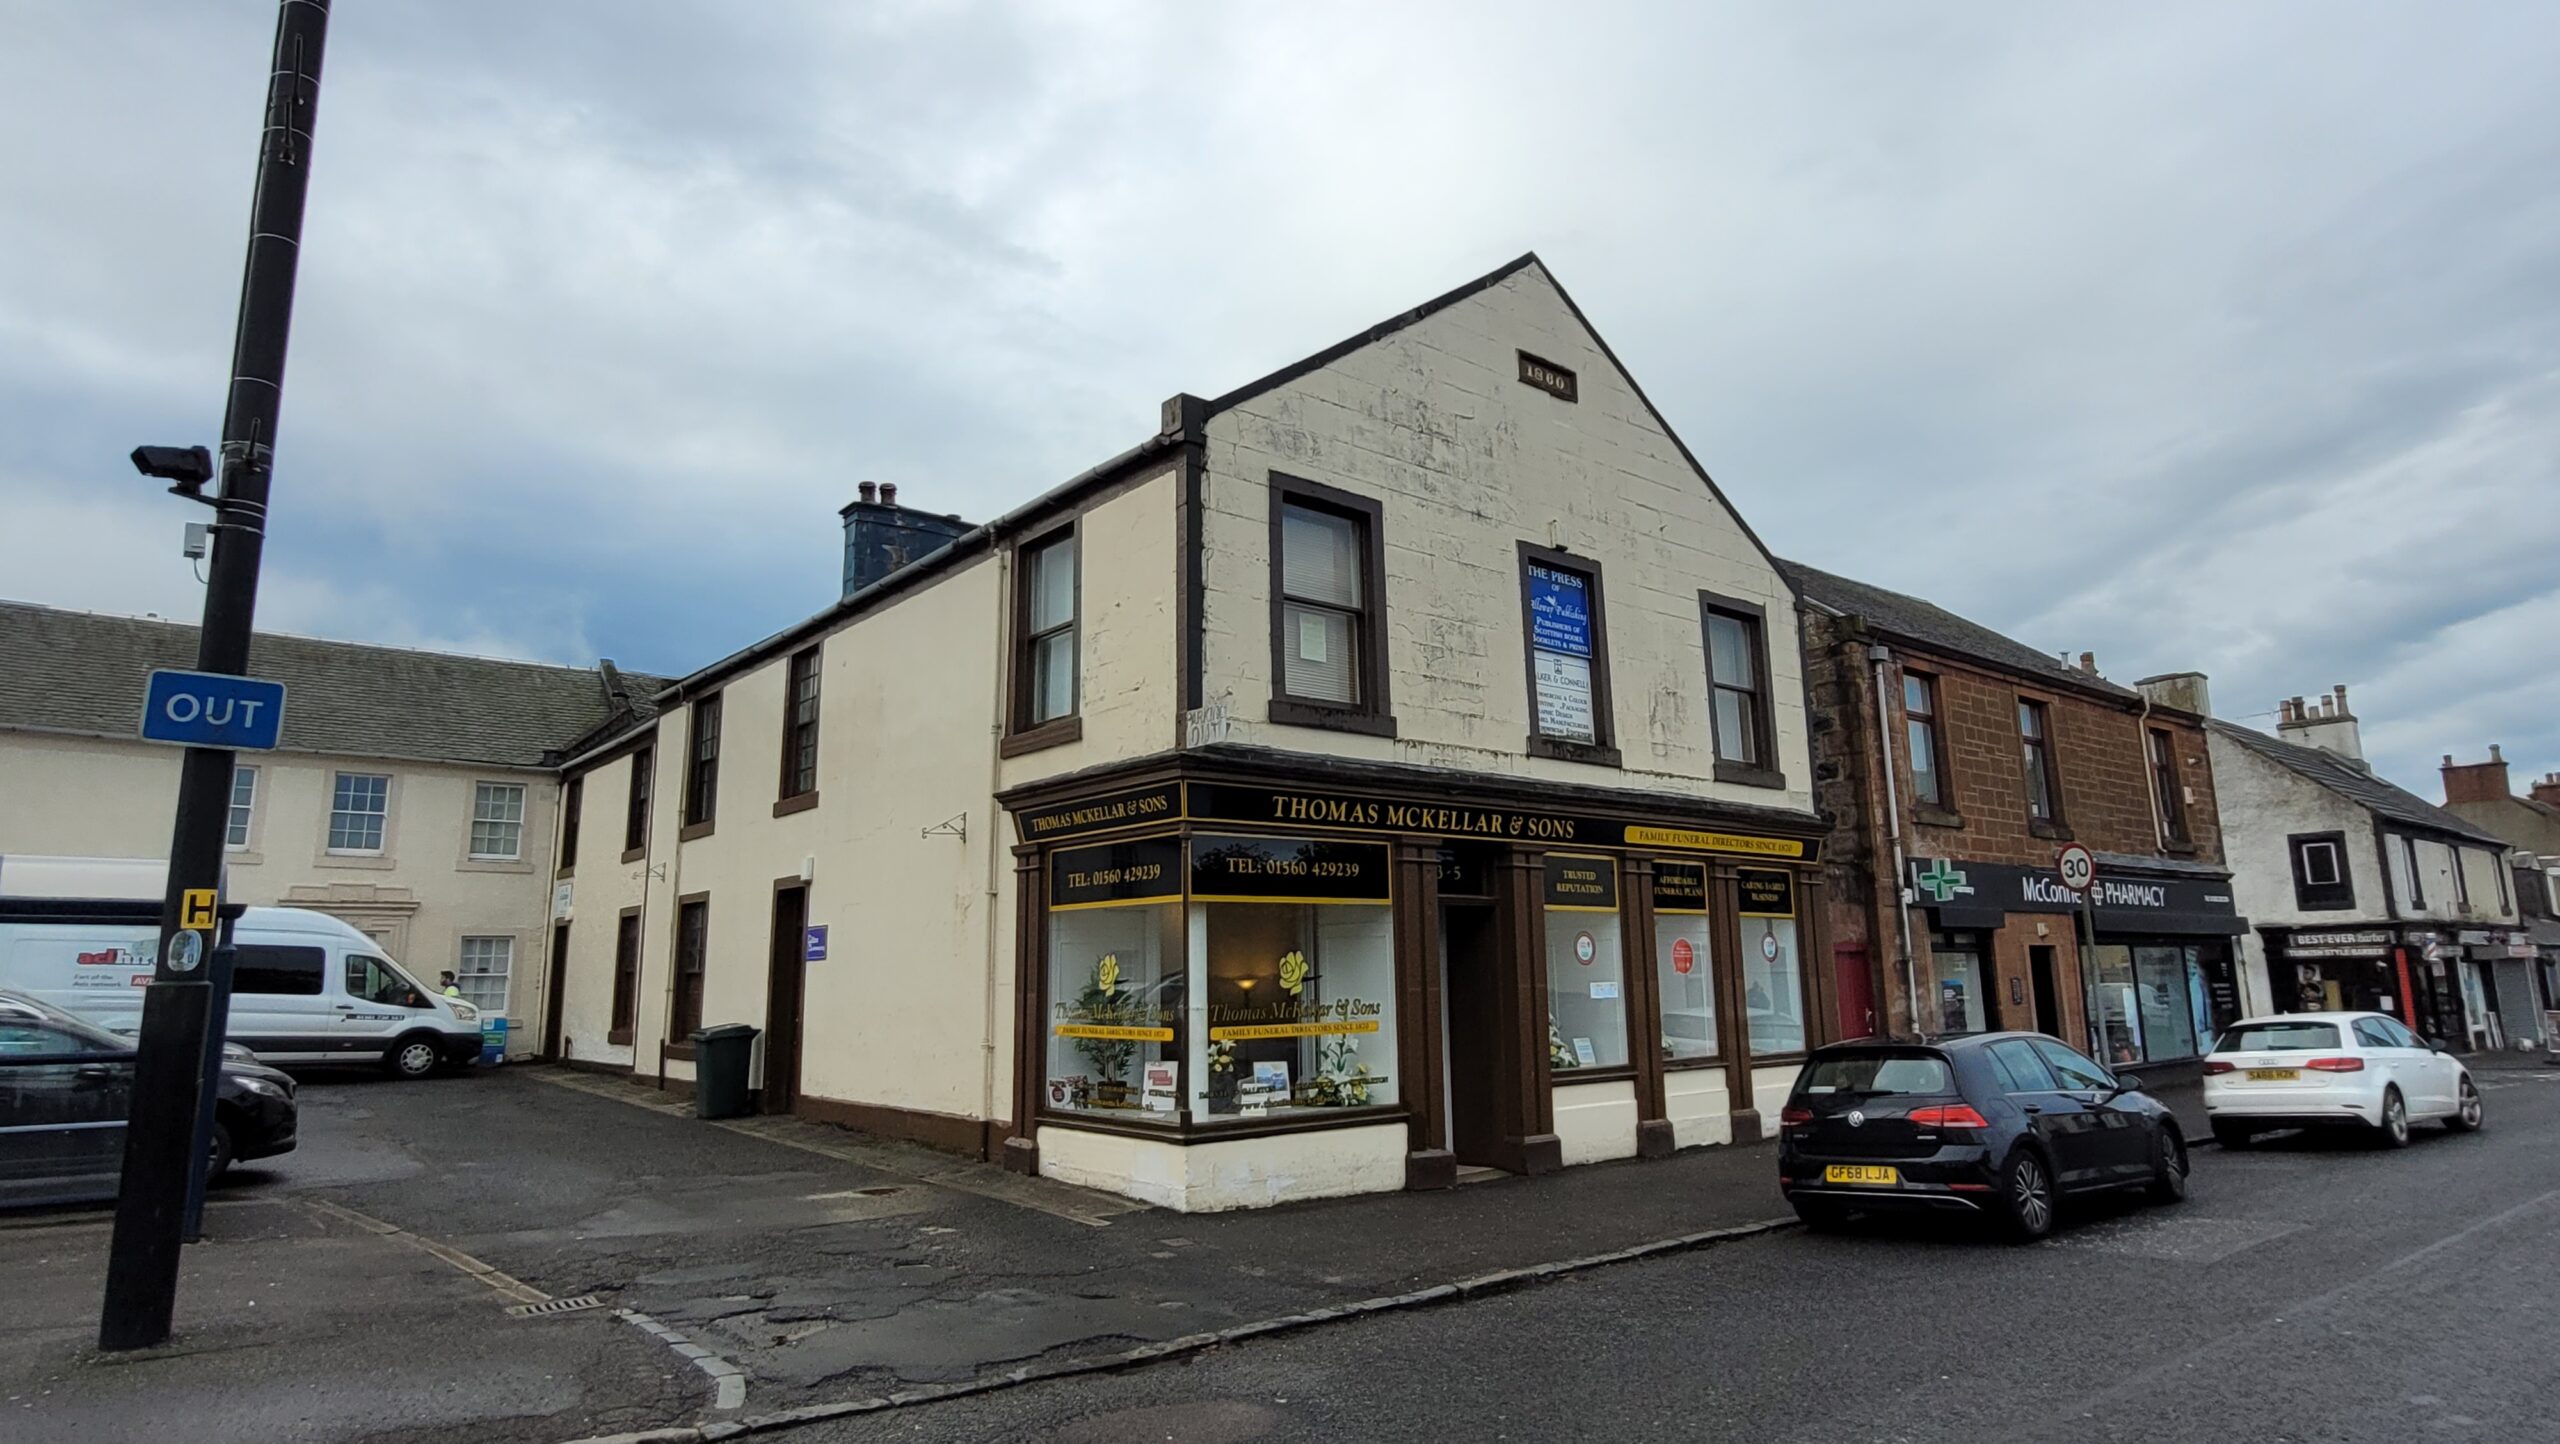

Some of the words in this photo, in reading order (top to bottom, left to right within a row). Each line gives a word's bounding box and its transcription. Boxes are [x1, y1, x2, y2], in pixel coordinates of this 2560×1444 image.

[1528, 565, 1548, 580] THE
[1551, 571, 1583, 589] PRESS
[166, 693, 264, 728] OUT
[1032, 812, 1071, 832] THOMAS
[1072, 802, 1126, 824] MCKELLAR
[1128, 800, 1137, 815] &
[1140, 795, 1168, 814] SONS
[1272, 796, 1379, 824] THOMAS
[1386, 805, 1502, 833] MCKELLAR
[1509, 816, 1524, 835] &
[1528, 818, 1575, 839] SONS
[1638, 830, 1671, 843] FAMILY
[1672, 833, 1710, 845] FUNERAL
[1712, 837, 1754, 849] DIRECTORS
[1755, 841, 1777, 851] SINCE
[1068, 872, 1091, 888] TEL:
[1093, 869, 1121, 886] 01560
[1123, 864, 1161, 882] 429239
[1226, 858, 1262, 874] TEL:
[1266, 859, 1307, 875] 01560
[1311, 862, 1360, 877] 429239
[1562, 870, 1597, 881] TRUSTED
[2064, 858, 2088, 879] 30
[1556, 883, 1604, 895] REPUTATION
[1654, 887, 1683, 896] FUNERAL
[2022, 876, 2082, 904] McConne
[2106, 882, 2165, 907] PHARMACY
[188, 894, 216, 924] H
[133, 976, 155, 985] AVI
[1210, 1003, 1267, 1022] Thomas
[1335, 998, 1349, 1016] &
[1351, 999, 1381, 1016] Sons
[1222, 1028, 1251, 1037] FAMILY
[1253, 1027, 1290, 1036] FUNERAL
[1291, 1025, 1331, 1034] DIRECTORS
[1333, 1023, 1353, 1032] SINCE
[1831, 1167, 1862, 1179] GF68
[1865, 1167, 1890, 1181] LJA
